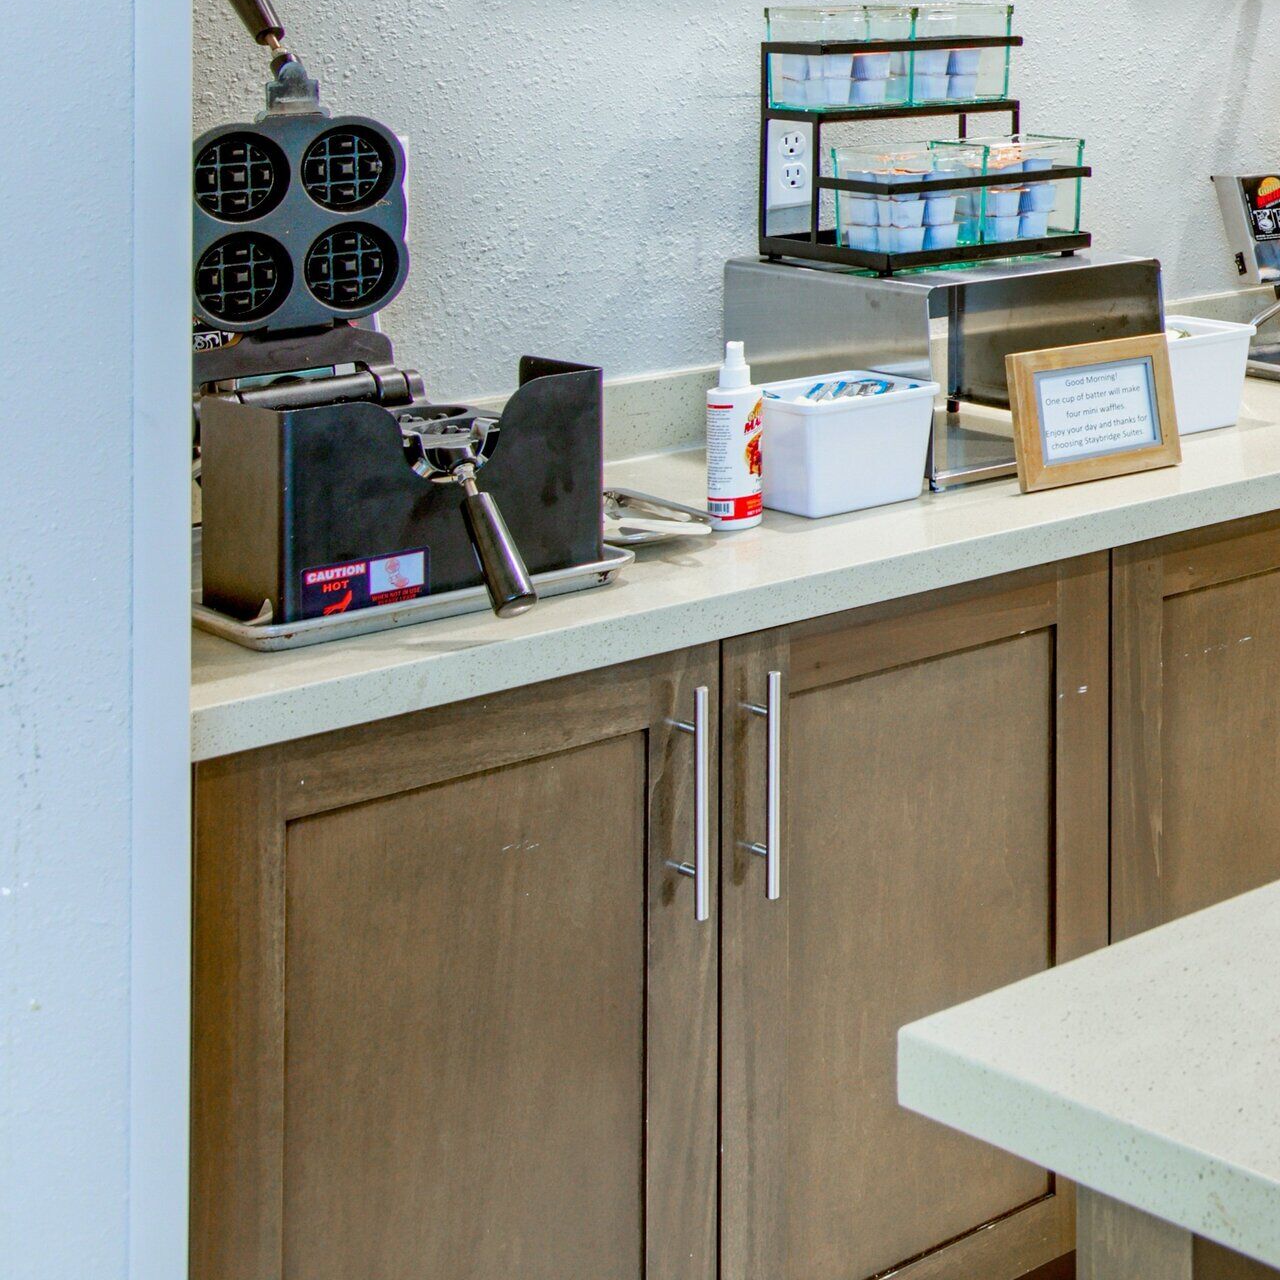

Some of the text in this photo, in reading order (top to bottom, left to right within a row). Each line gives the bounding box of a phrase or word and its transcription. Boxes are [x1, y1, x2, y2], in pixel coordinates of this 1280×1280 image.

[1065, 372, 1118, 386] Good Morning!
[1045, 384, 1141, 406] One cup of batter will make
[1066, 409, 1081, 418] four
[1083, 407, 1099, 416] mini
[1045, 414, 1148, 439] Enjoy your day and thanks for
[1051, 439, 1083, 450] choosing
[1084, 432, 1121, 445] Staybridge
[307, 563, 366, 584] CAUTION
[322, 580, 350, 593] HOT
[372, 593, 389, 602] WHEN
[389, 589, 402, 599] NOT
[402, 588, 409, 596] IN
